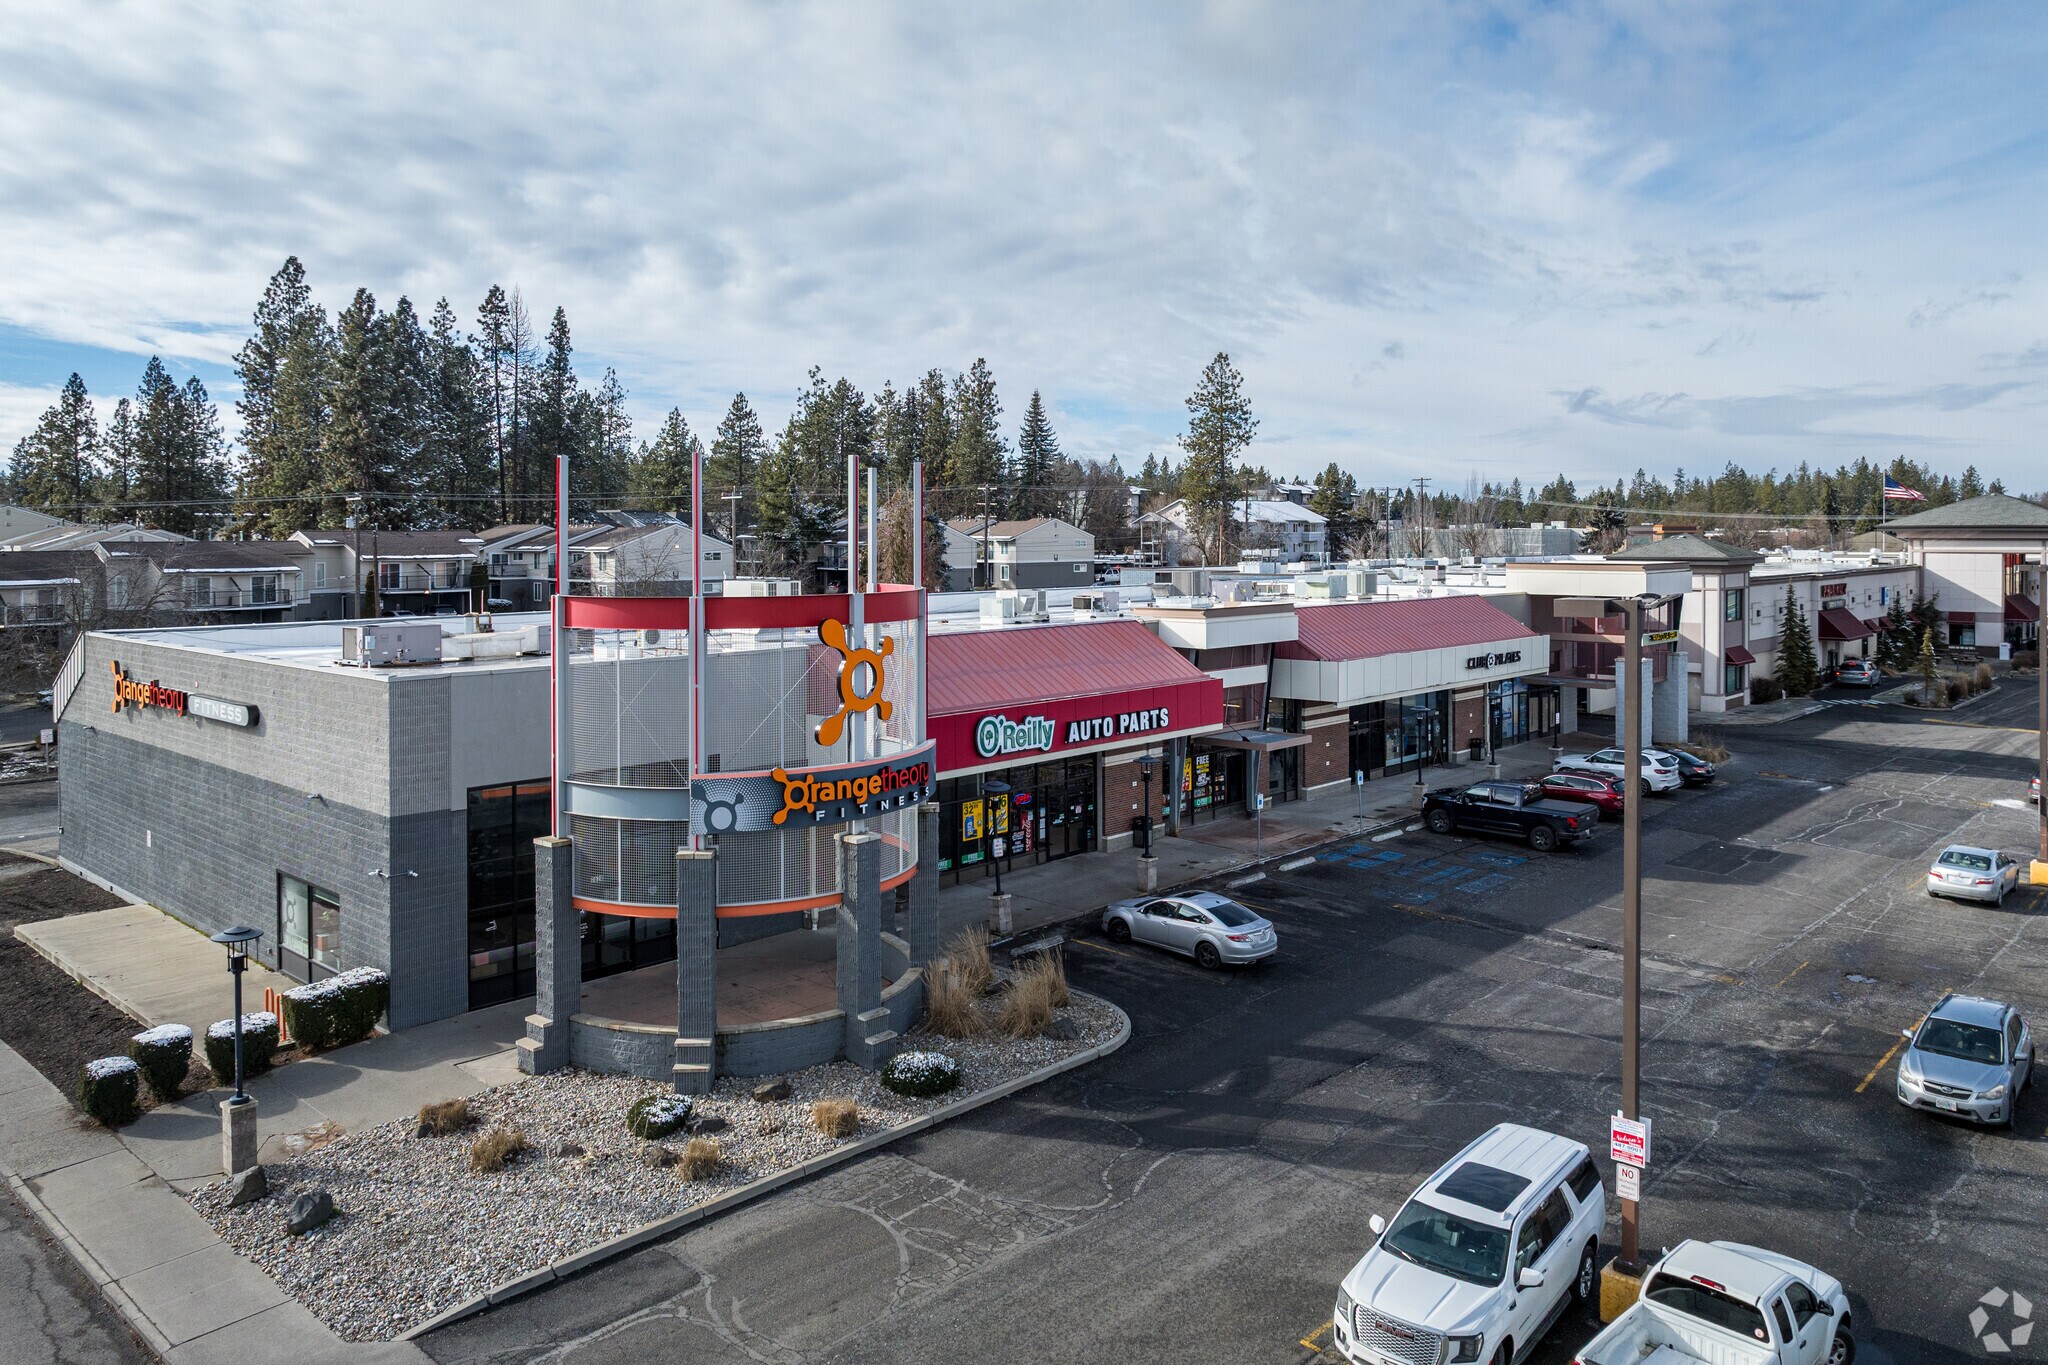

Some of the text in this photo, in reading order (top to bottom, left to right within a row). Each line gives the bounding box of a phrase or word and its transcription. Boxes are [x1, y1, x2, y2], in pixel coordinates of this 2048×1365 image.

[1466, 651, 1521, 669] CLUB PILATES
[194, 700, 243, 723] FITNESS
[978, 707, 1170, 757] O'Reilly AUTO PARTS
[1196, 755, 1209, 765] FREE
[815, 786, 930, 822] FITNESS
[1621, 1169, 1634, 1179] NO
[1376, 1320, 1415, 1342] GMC
